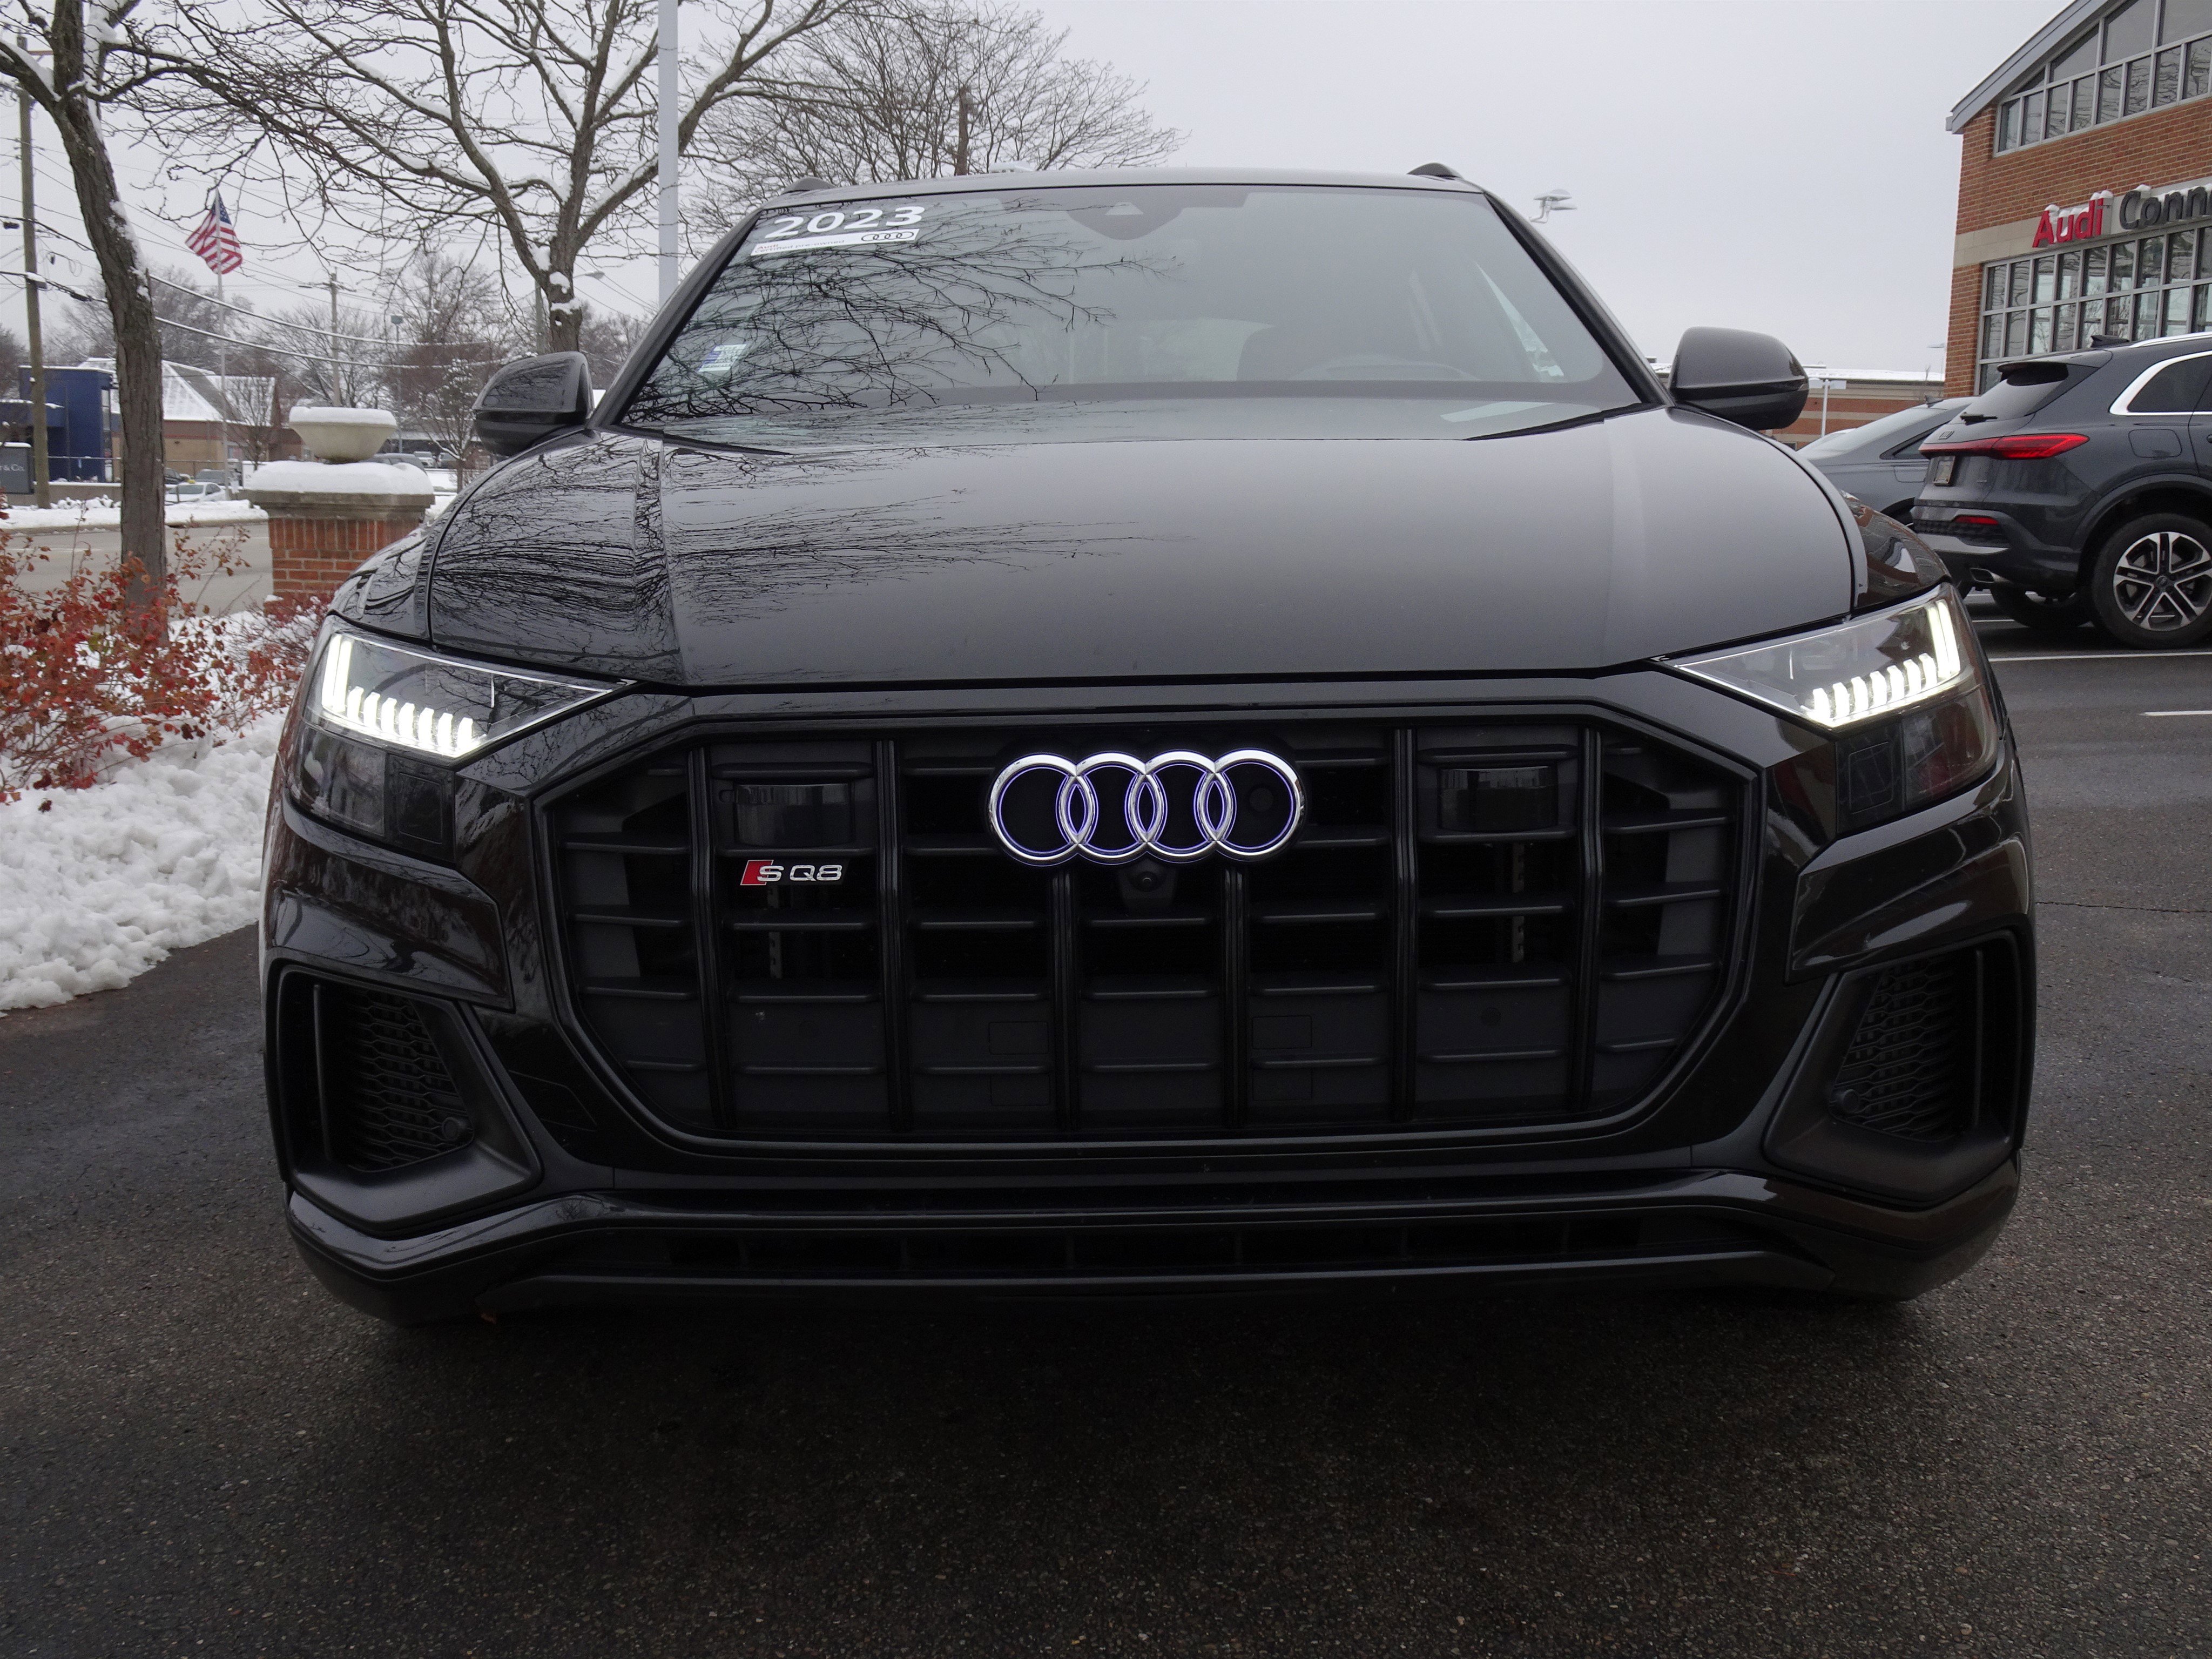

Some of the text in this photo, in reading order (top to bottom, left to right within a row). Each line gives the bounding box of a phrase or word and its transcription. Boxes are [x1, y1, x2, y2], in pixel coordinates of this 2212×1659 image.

[765, 206, 925, 239] 2023
[2032, 186, 2212, 248] Audi Conn
[795, 240, 845, 249] pre-owned
